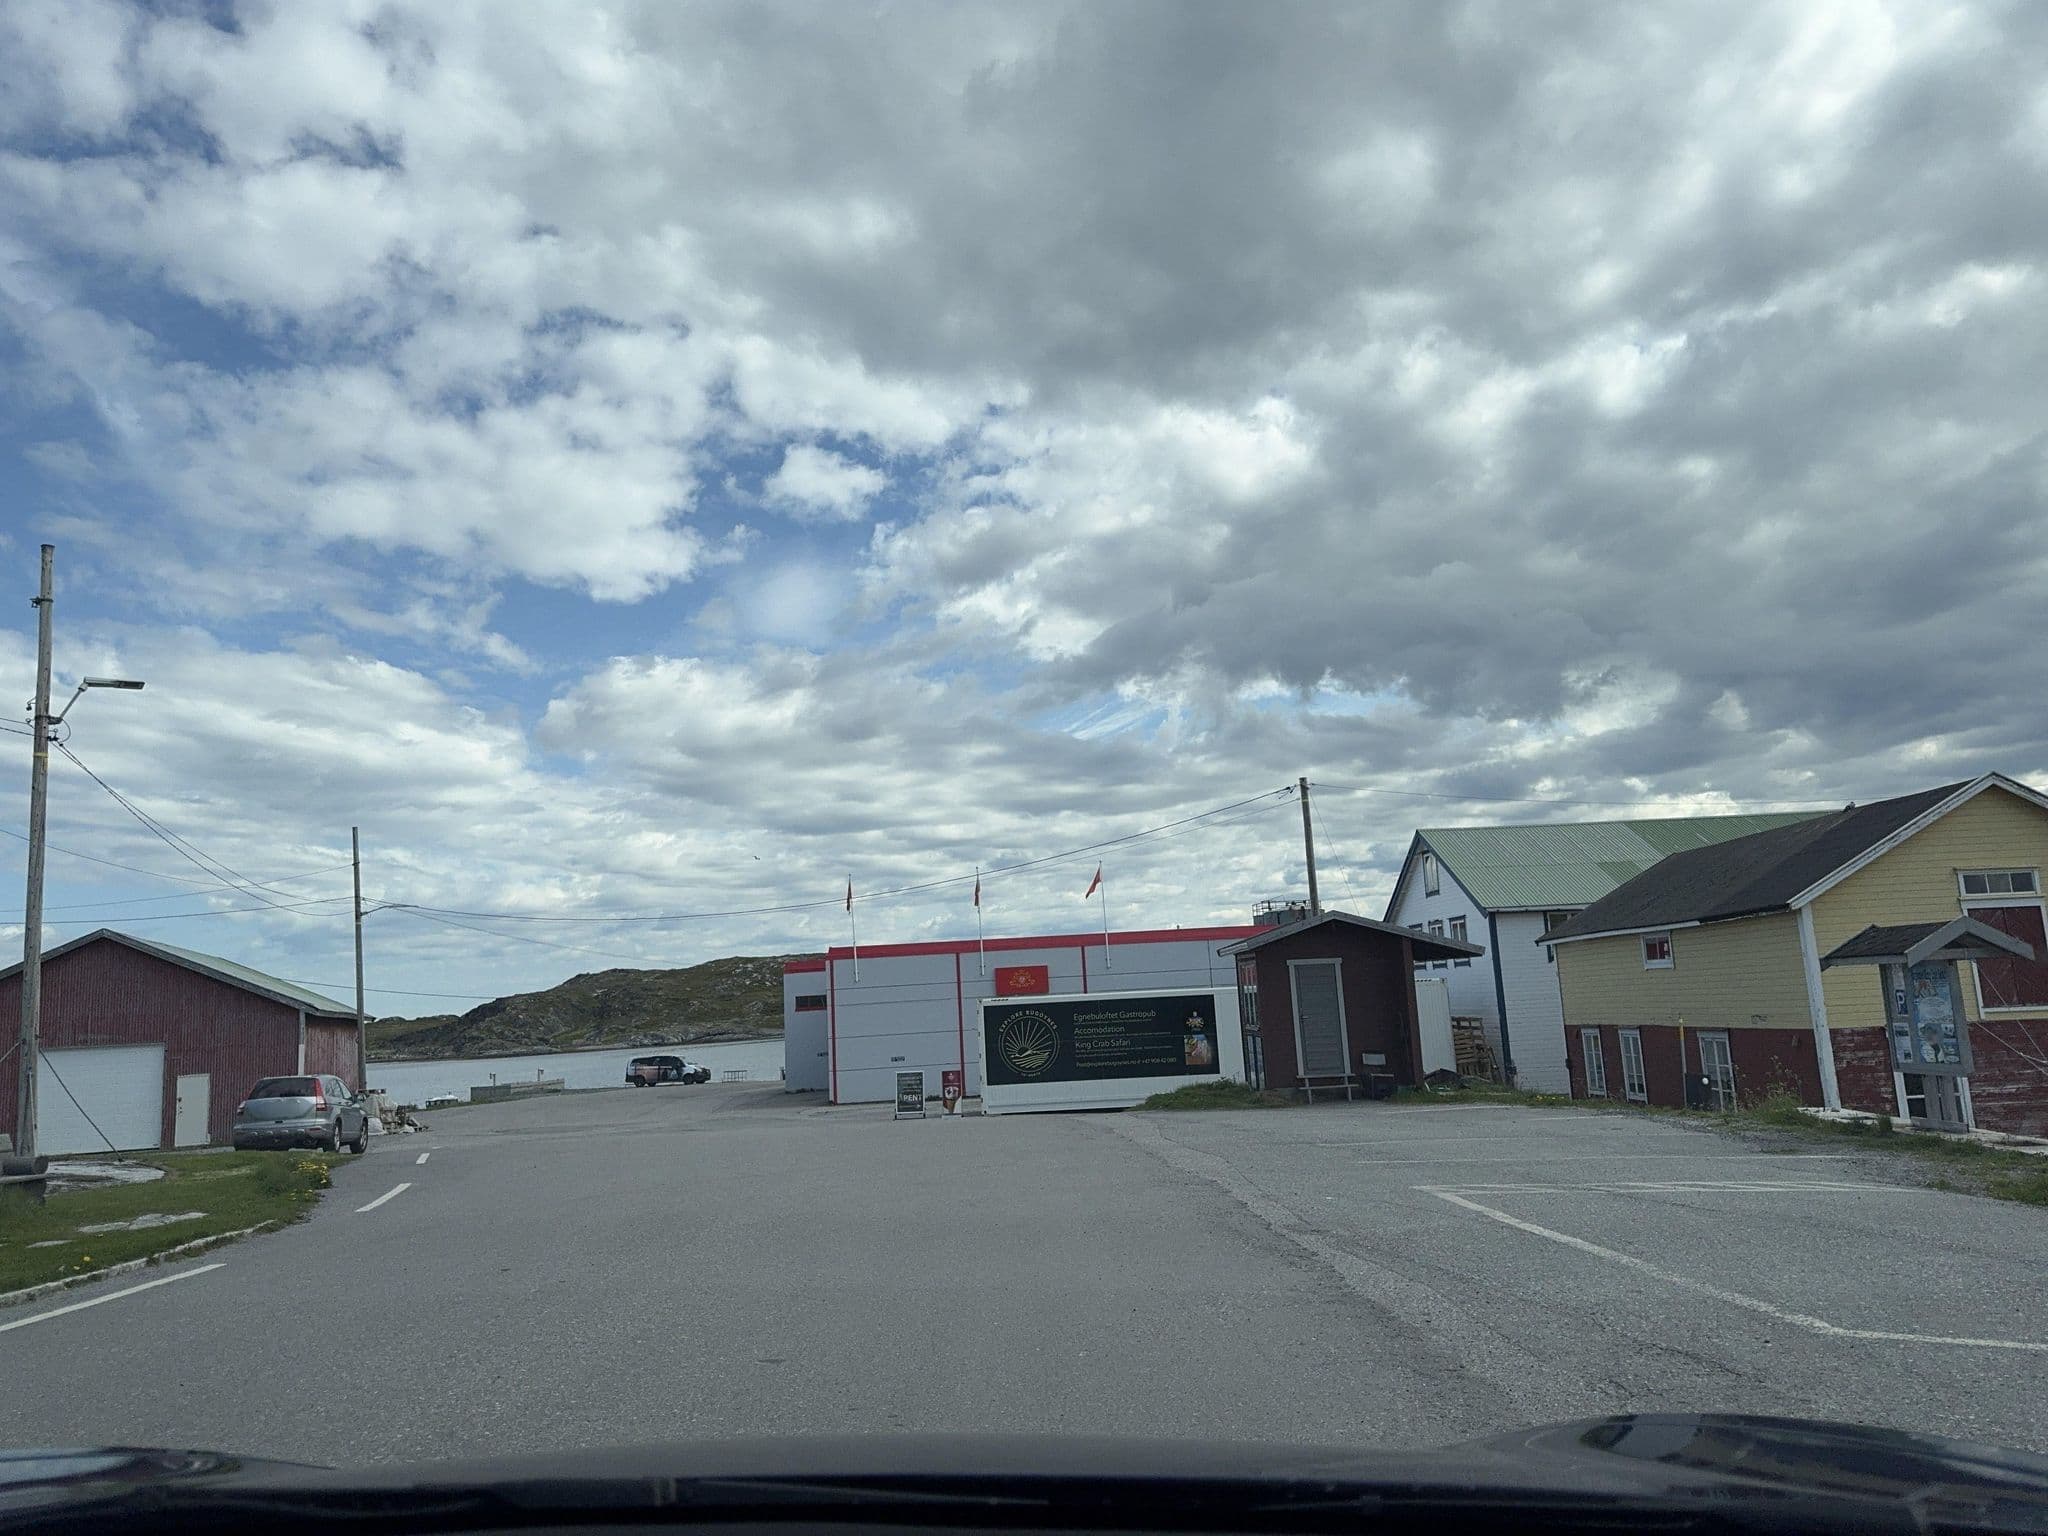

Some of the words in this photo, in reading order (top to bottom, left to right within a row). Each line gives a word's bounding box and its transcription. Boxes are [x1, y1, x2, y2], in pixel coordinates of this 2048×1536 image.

[1896, 991, 1905, 1014] P
[999, 1010, 1023, 1032] EXPLORE
[1119, 1010, 1156, 1020] Gastropub
[1075, 1041, 1092, 1050] King
[1092, 1039, 1110, 1047] Crab
[1111, 1038, 1131, 1047] Safari
